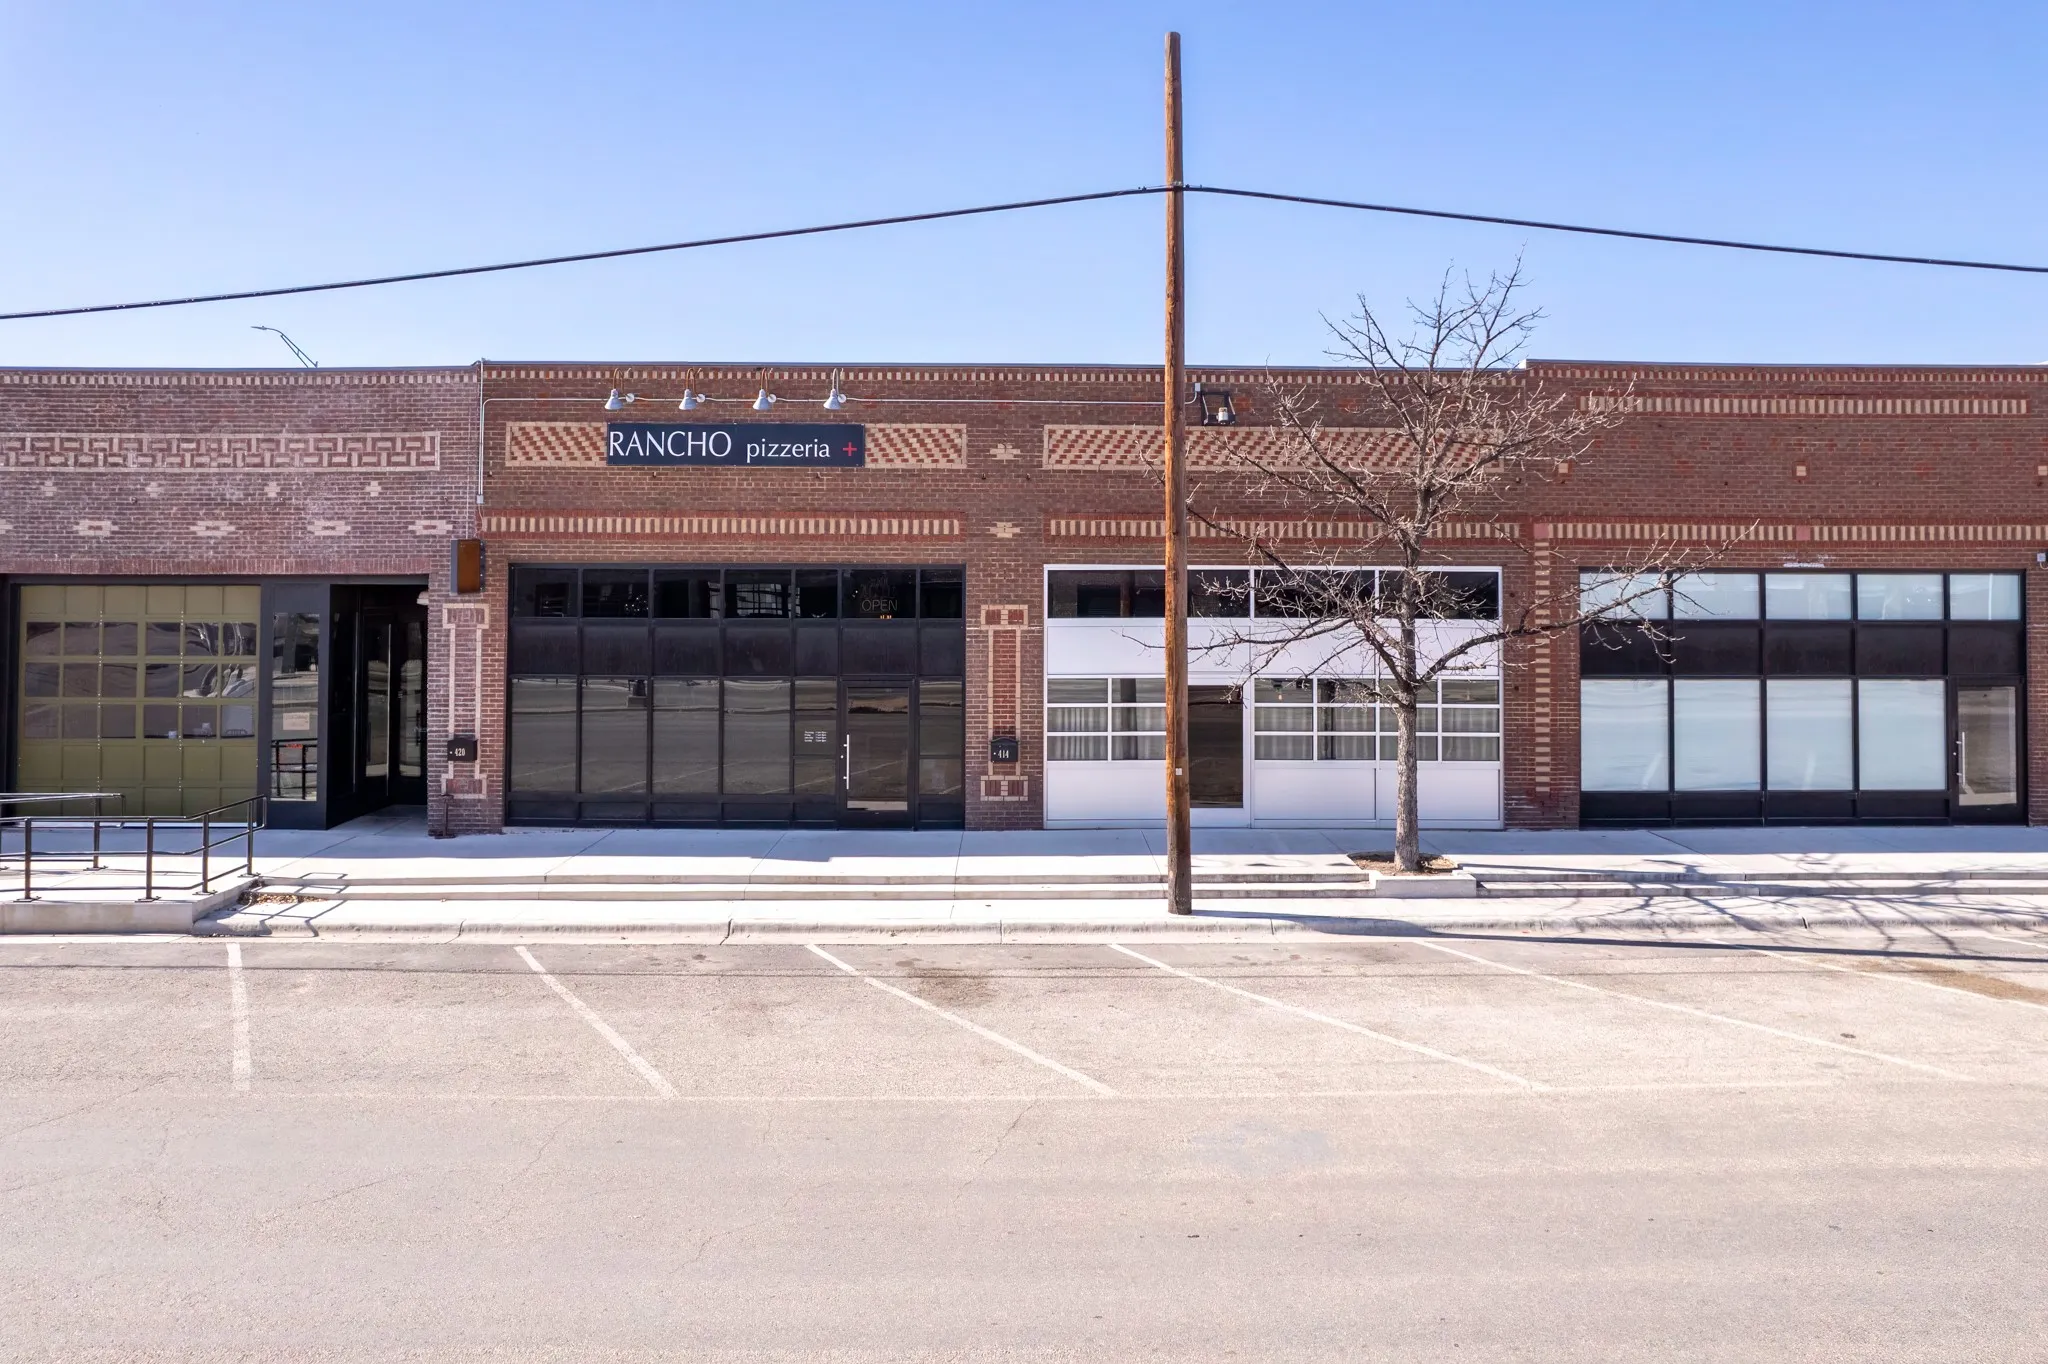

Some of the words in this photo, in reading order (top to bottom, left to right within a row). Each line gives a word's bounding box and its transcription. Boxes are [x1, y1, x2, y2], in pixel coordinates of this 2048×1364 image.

[609, 430, 732, 457] RANCHO
[746, 438, 830, 463] pizzeria
[861, 599, 898, 612] OPEN
[454, 748, 466, 757] 420
[997, 749, 1009, 759] 414
